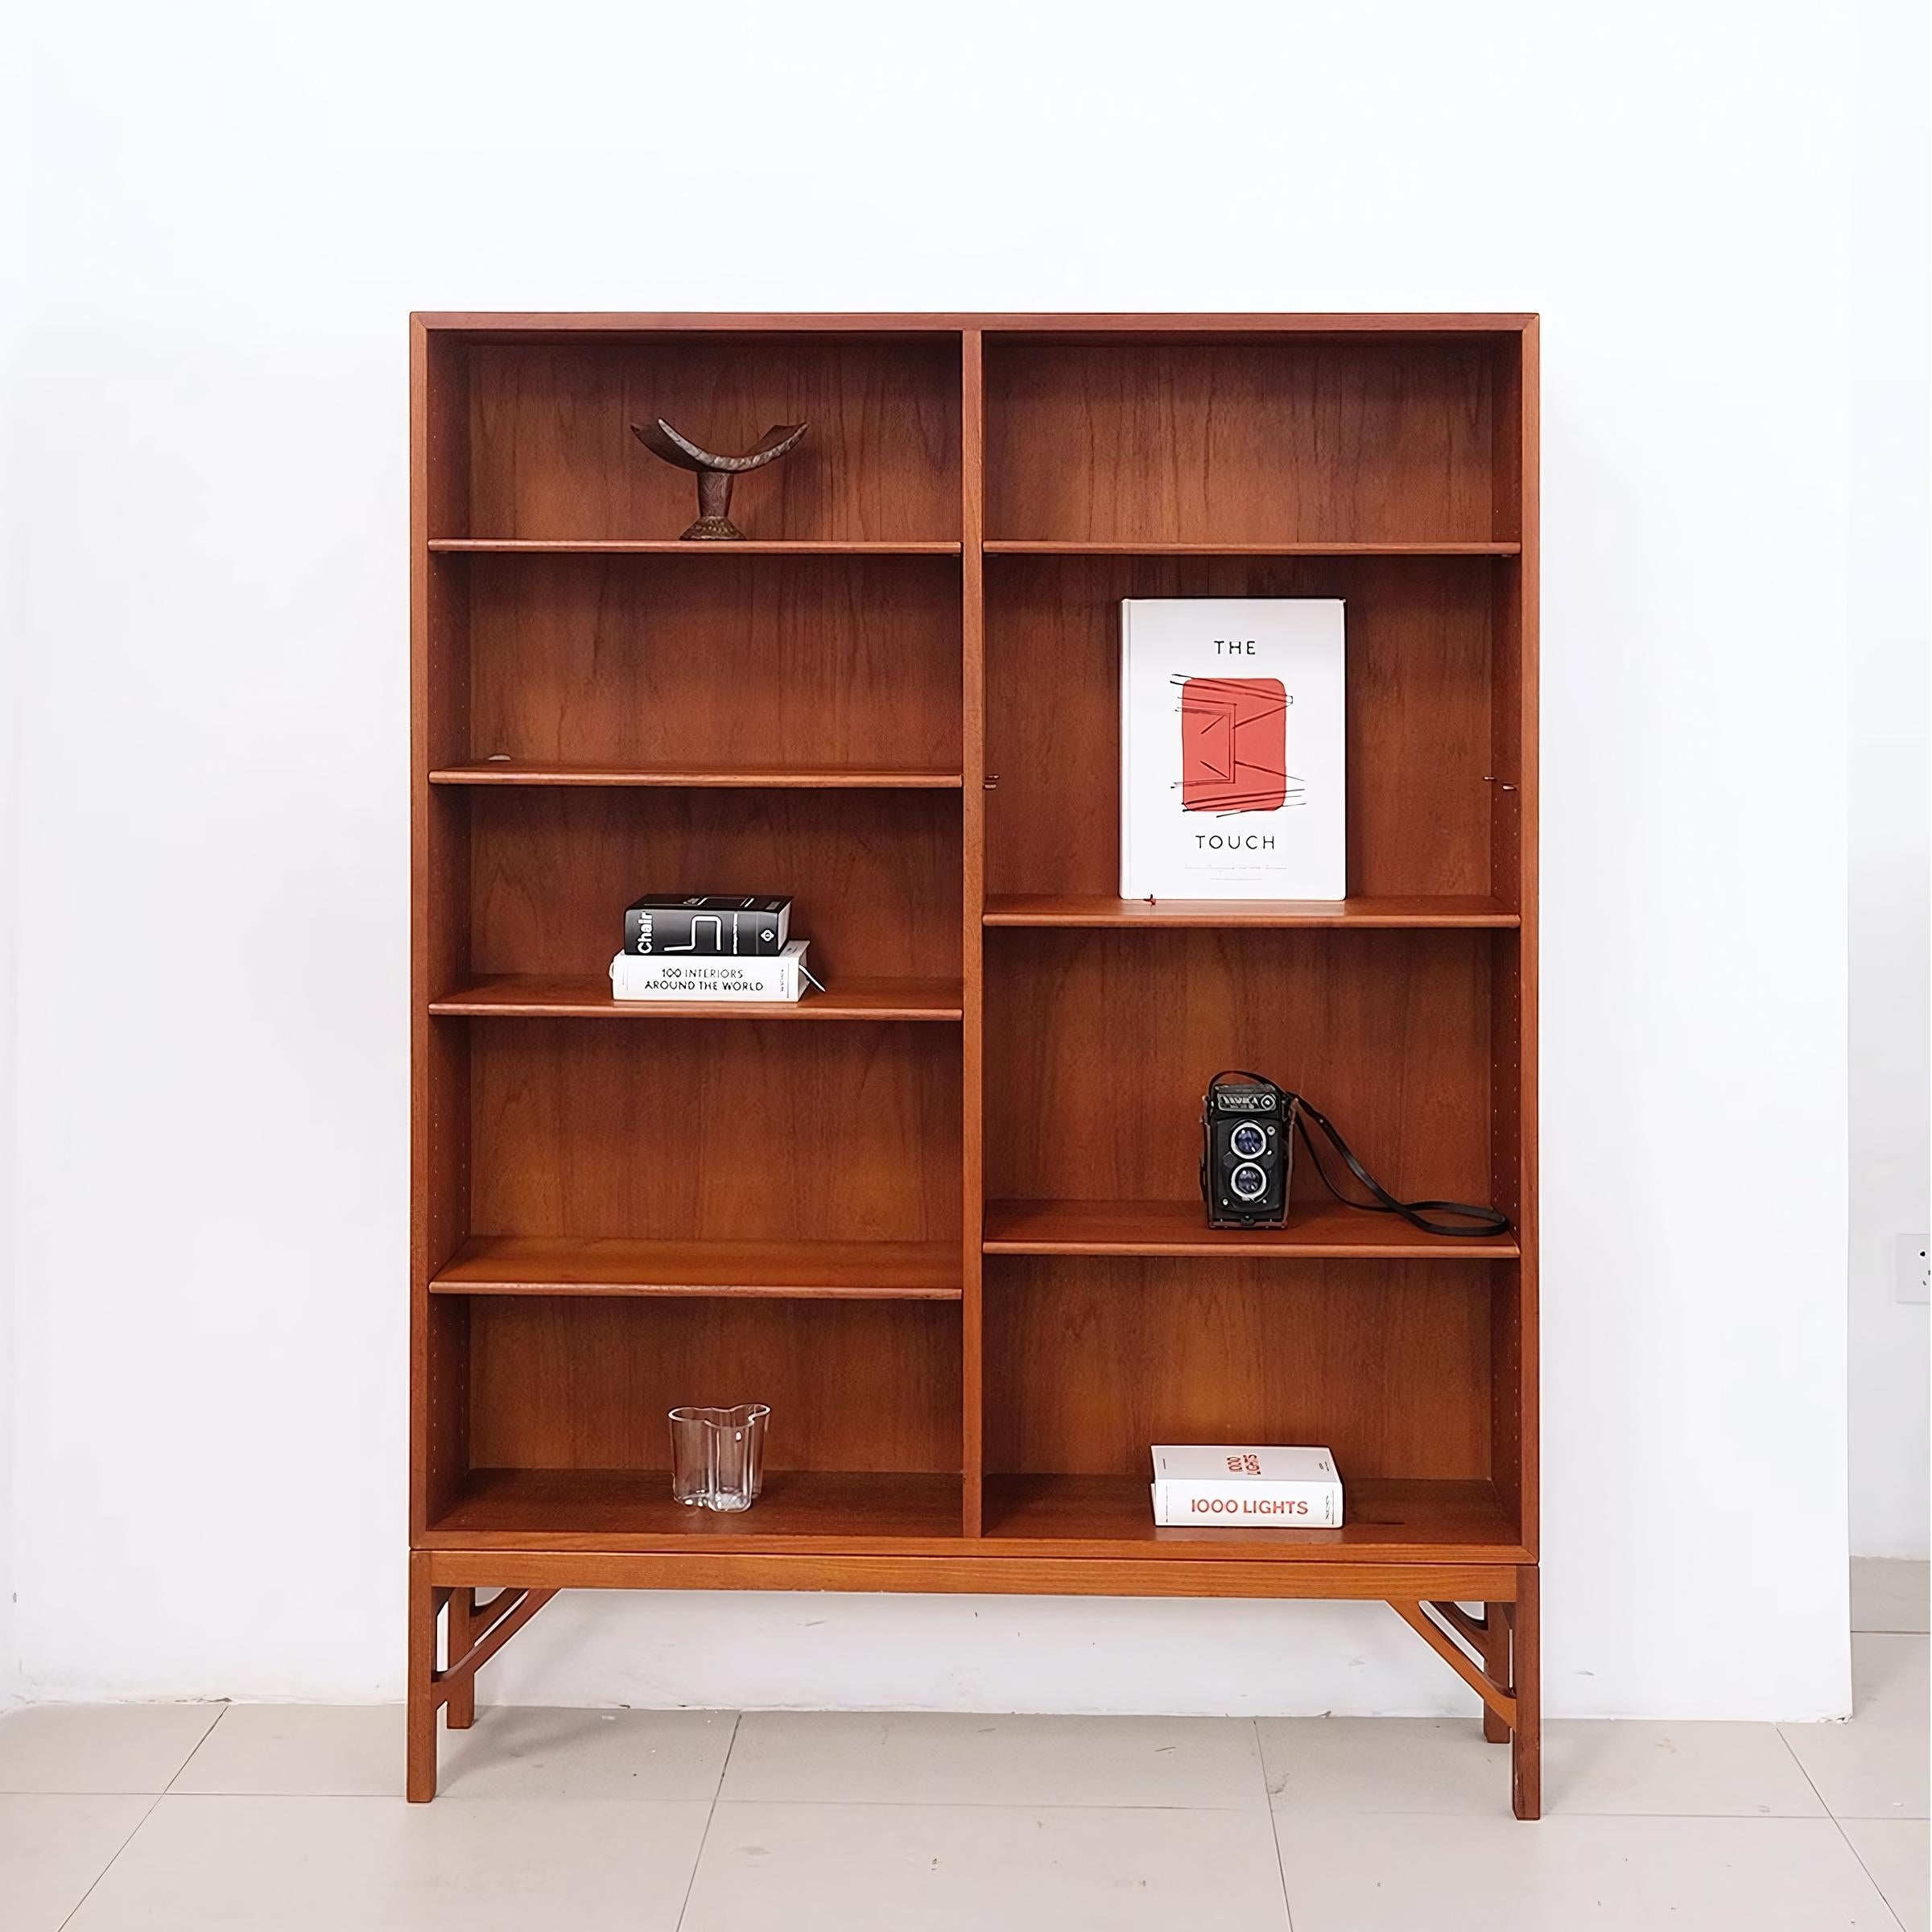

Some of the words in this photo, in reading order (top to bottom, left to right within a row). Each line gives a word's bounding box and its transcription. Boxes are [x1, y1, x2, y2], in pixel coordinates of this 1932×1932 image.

[1213, 640, 1257, 655] THE
[1195, 834, 1275, 850] TOUCH
[637, 911, 654, 955] Chair
[661, 968, 681, 979] 100
[684, 968, 743, 979] INTERIORS
[643, 980, 696, 992] AROUND
[699, 980, 718, 993] THE
[721, 981, 764, 993] WORLD
[1191, 1499, 1238, 1513] 1000
[1243, 1500, 1309, 1515] LIGHTS
